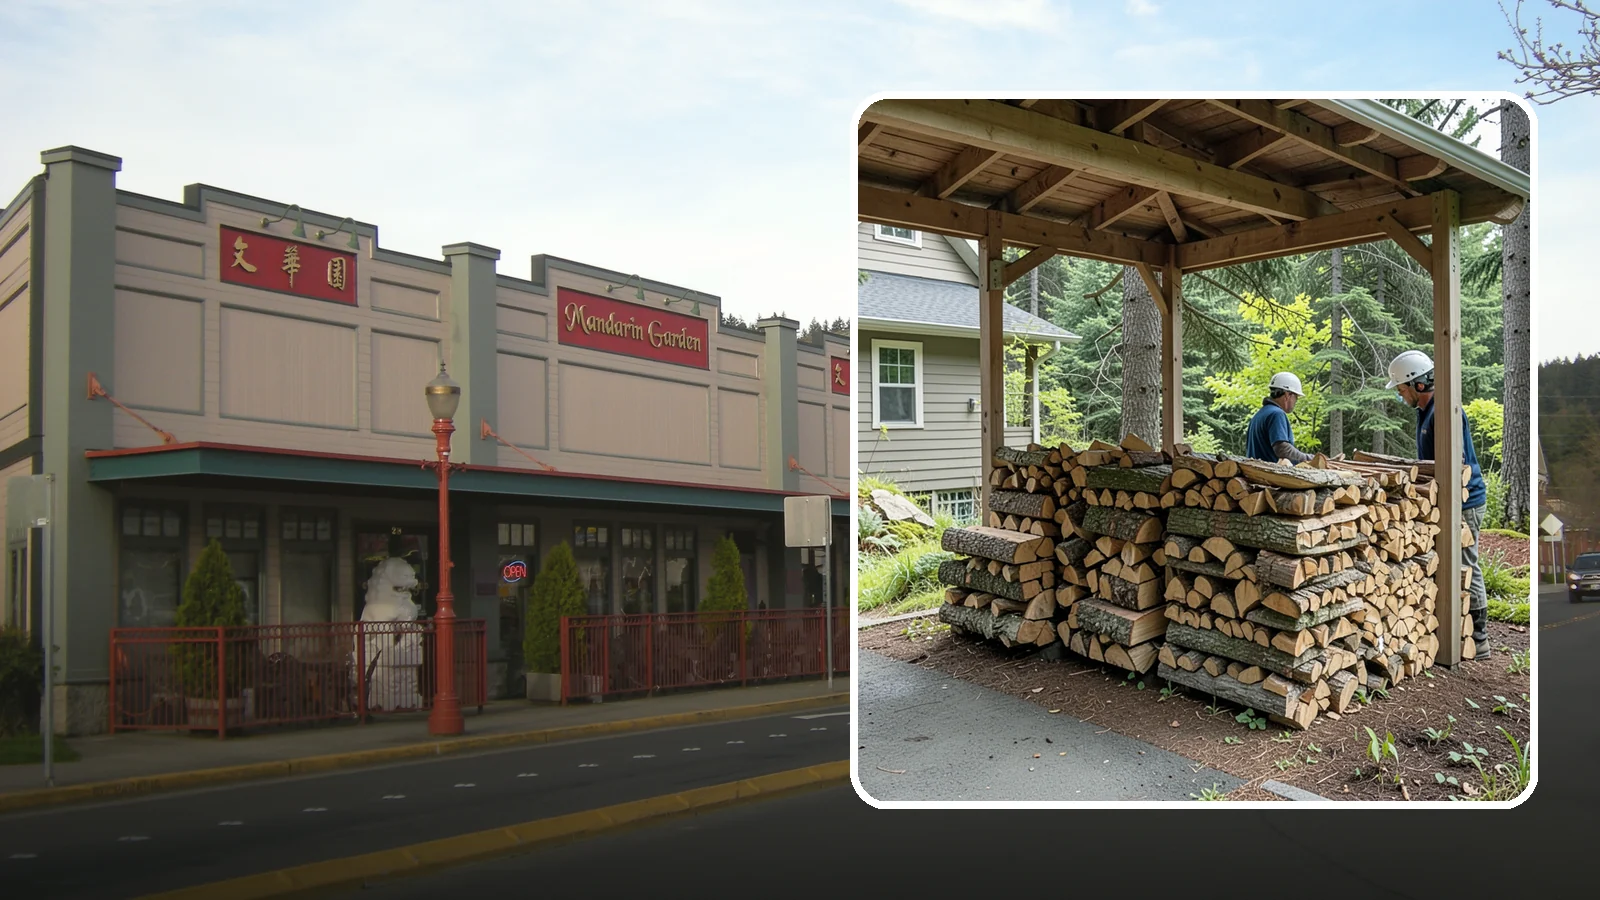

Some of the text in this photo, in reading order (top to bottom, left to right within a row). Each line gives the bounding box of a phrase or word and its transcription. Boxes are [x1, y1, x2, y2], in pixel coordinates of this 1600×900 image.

[231, 235, 346, 291] 文華園
[564, 302, 702, 352] Mandarin Garden
[503, 565, 526, 577] OPEN
